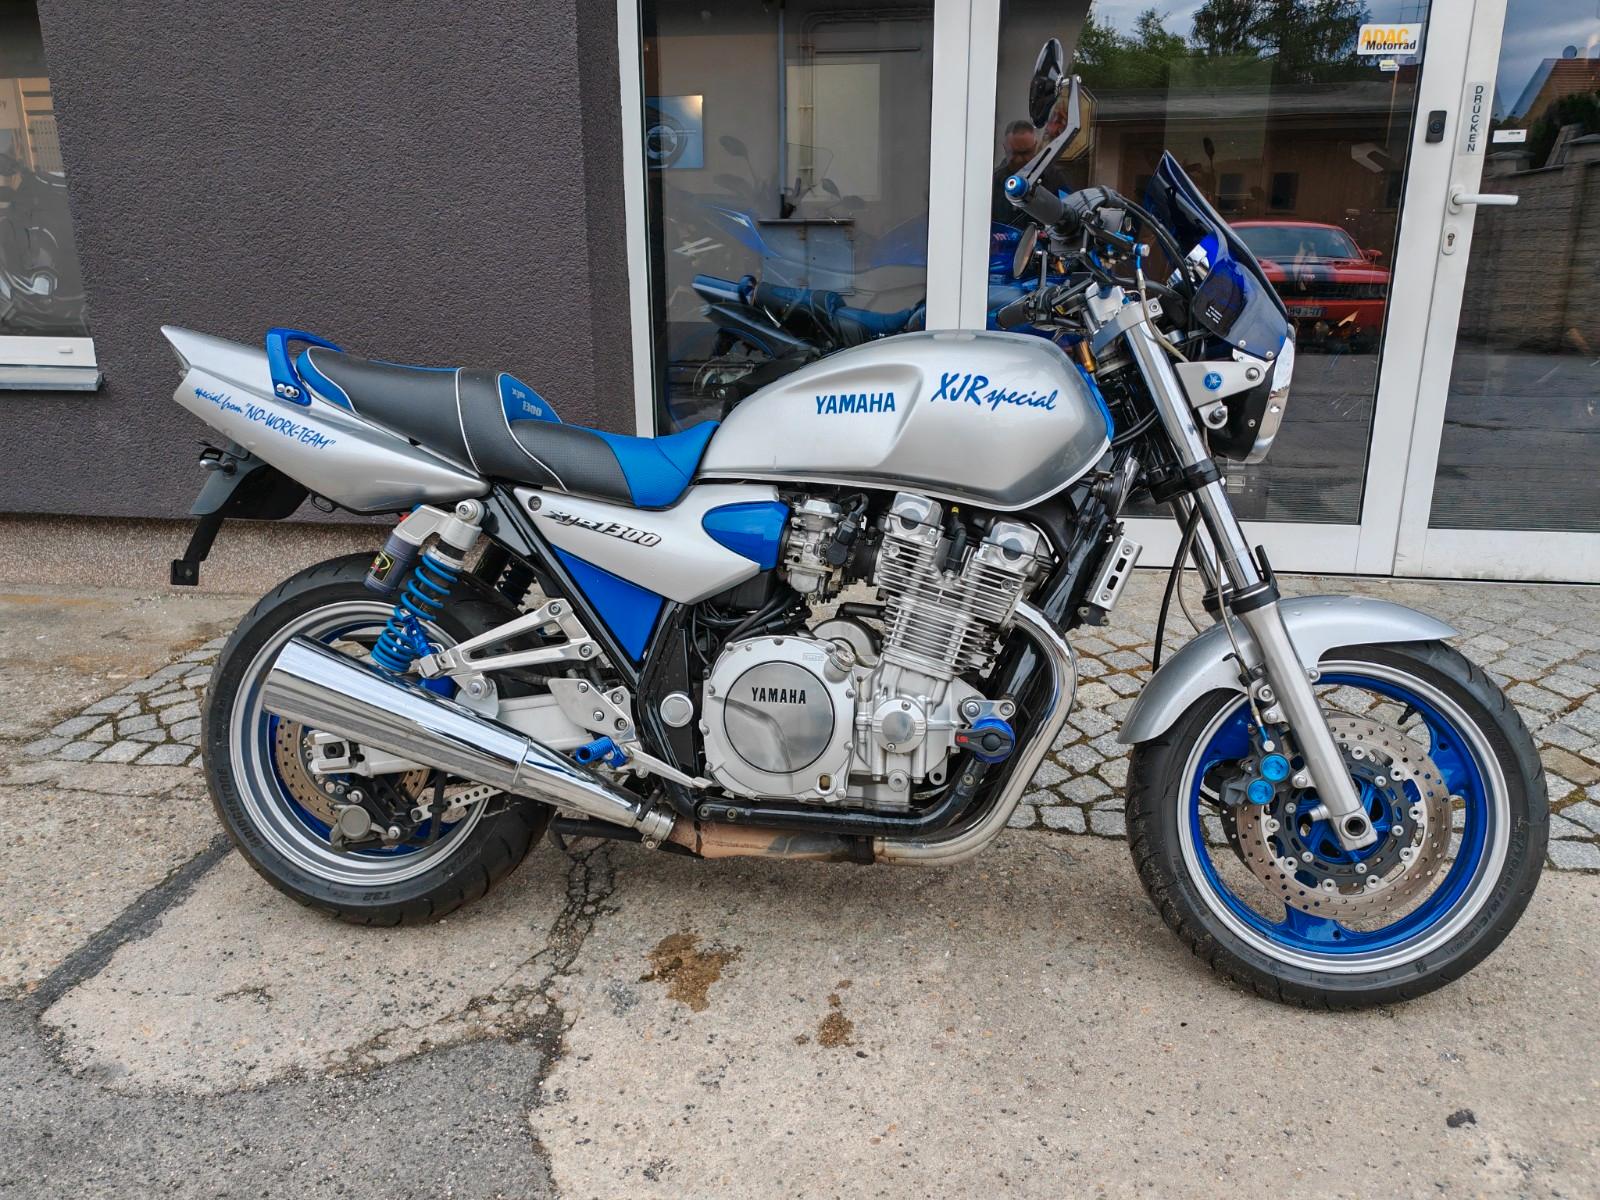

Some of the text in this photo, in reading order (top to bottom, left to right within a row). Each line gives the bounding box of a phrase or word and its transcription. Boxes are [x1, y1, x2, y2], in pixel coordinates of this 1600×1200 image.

[1360, 28, 1409, 47] ADAC
[1366, 40, 1417, 51] Motorrad
[1467, 85, 1484, 153] DRUCKEN
[220, 396, 243, 414] from
[815, 392, 896, 415] YAMAHA
[751, 686, 807, 705] YAMAHA
